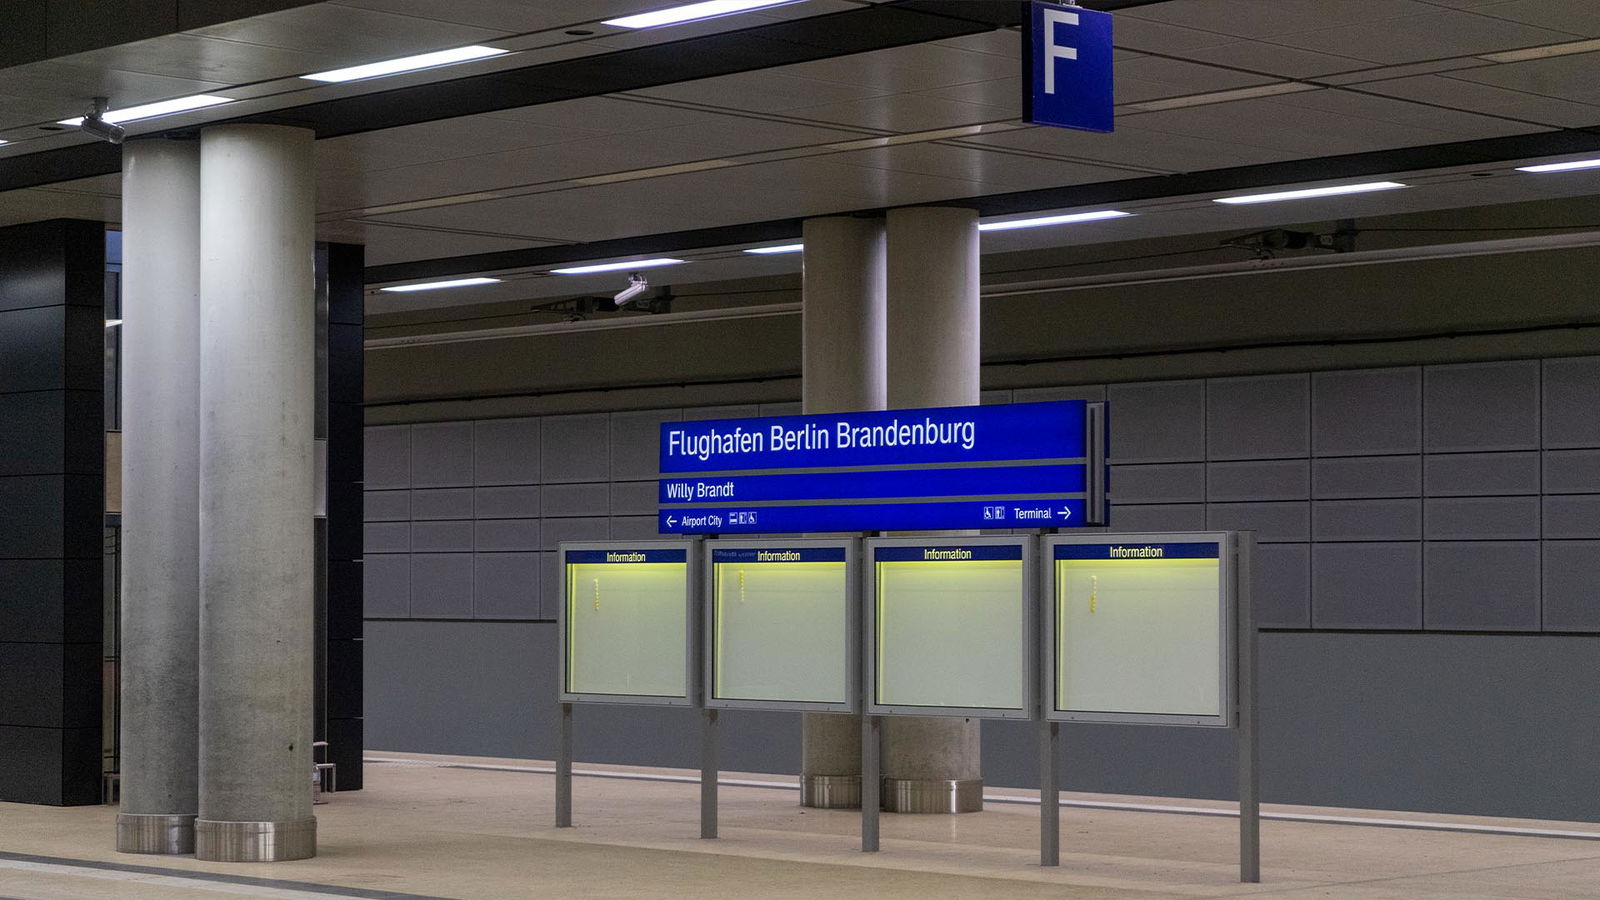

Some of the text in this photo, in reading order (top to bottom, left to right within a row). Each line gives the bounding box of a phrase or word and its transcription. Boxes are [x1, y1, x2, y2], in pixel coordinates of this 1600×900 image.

[1043, 8, 1080, 95] F
[669, 418, 976, 462] Flughafen Berlin Brandenburg
[666, 481, 735, 501] Willy Brandt
[1013, 507, 1052, 519] Terminal
[681, 515, 723, 528] Airport City
[606, 552, 646, 562] Information
[757, 550, 801, 561] Information
[924, 548, 972, 560] Information
[1110, 546, 1163, 558] Information
